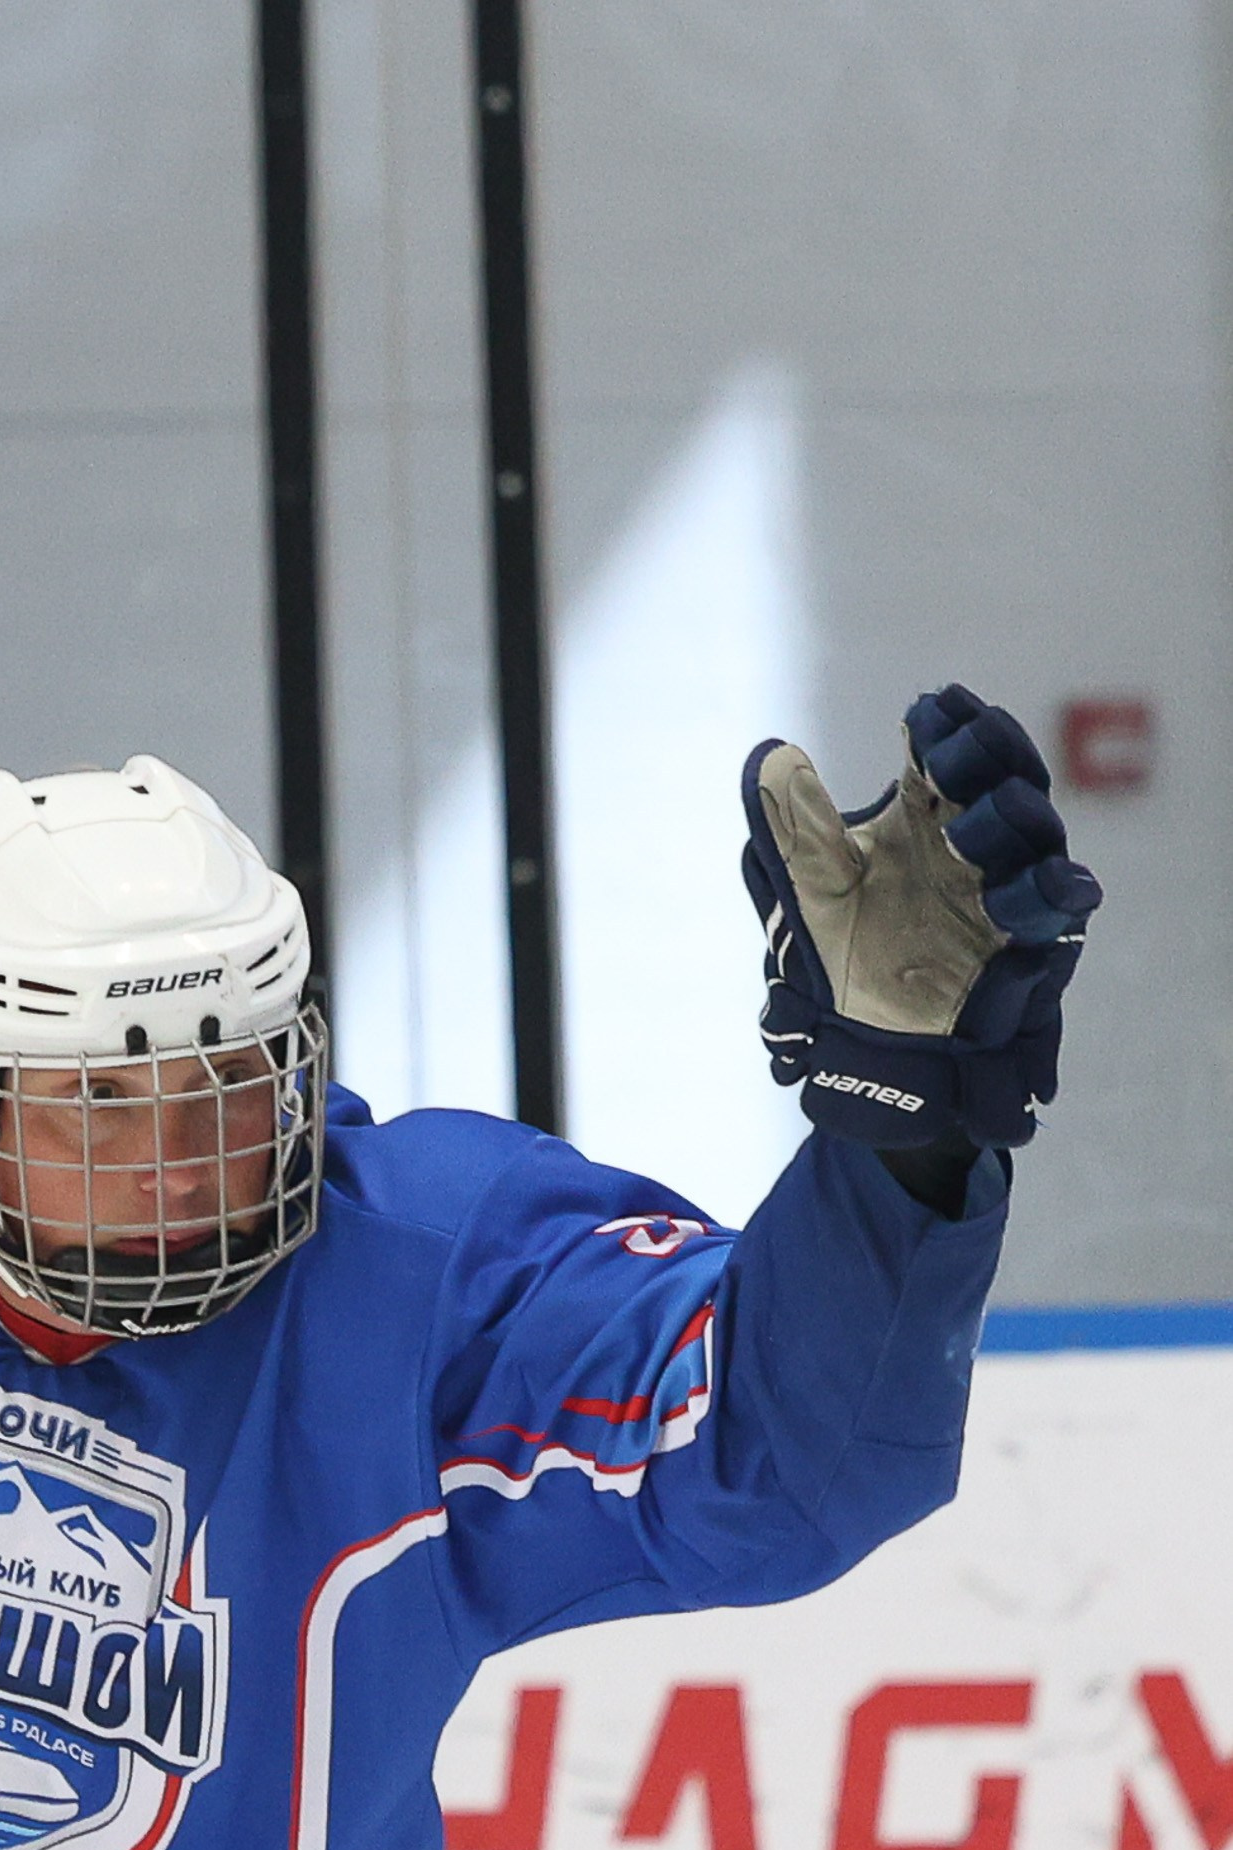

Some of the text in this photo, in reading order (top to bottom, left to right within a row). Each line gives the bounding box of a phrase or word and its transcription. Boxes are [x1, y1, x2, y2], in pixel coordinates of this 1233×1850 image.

[104, 966, 227, 999] BAUER
[811, 1069, 925, 1113] BAUER
[49, 1569, 122, 1609] КЛУБ
[10, 1716, 96, 1769] PALACE
